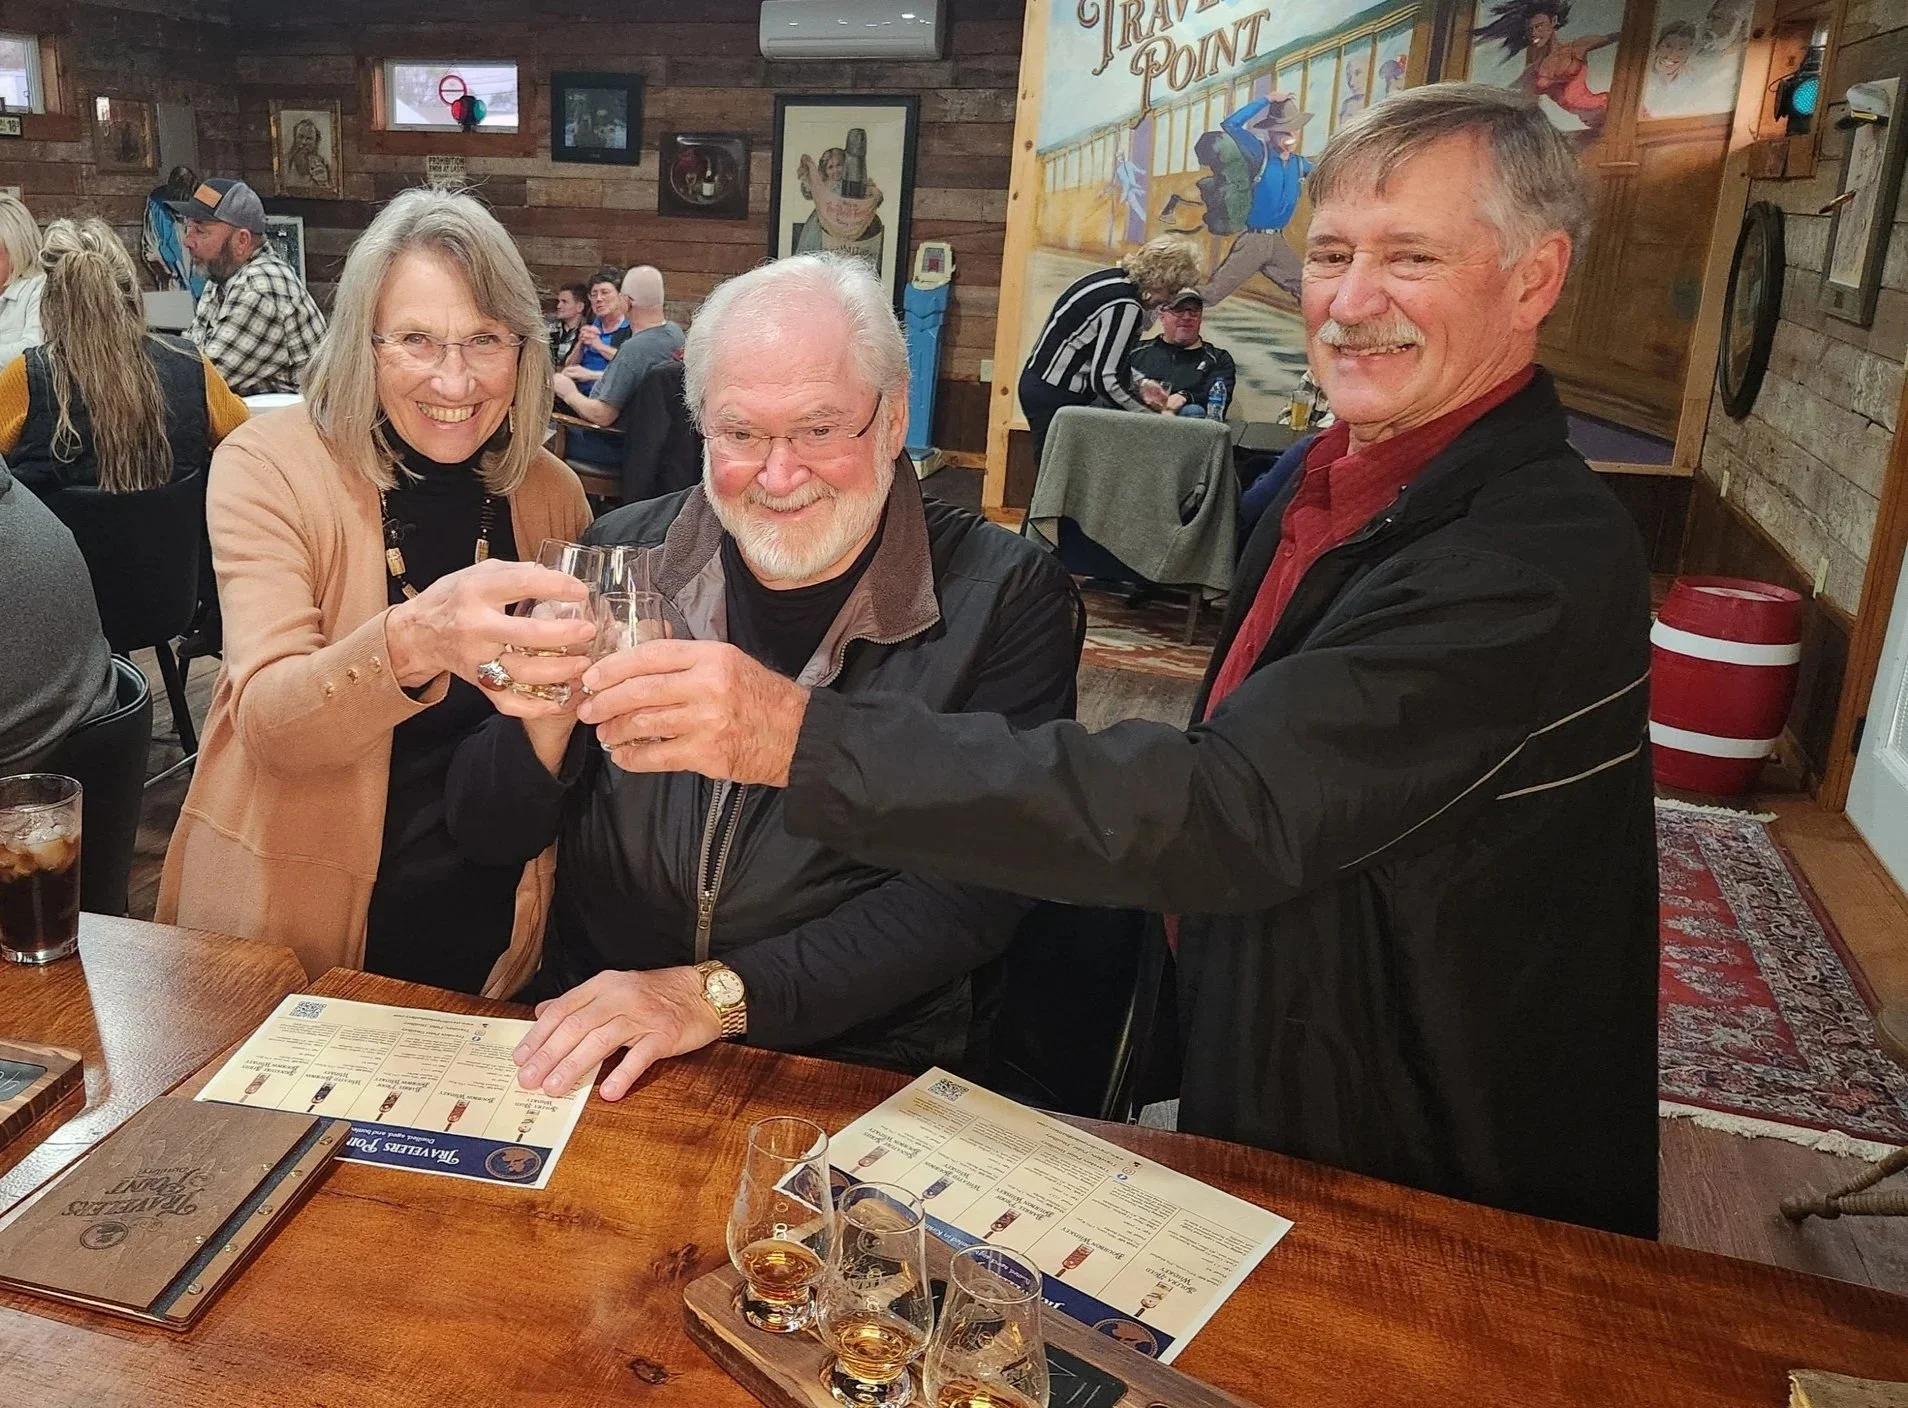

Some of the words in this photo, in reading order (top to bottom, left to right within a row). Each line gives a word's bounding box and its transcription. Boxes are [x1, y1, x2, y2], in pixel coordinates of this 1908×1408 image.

[1129, 8, 1270, 129] POINT
[383, 1141, 460, 1165] TRAVELERS
[1066, 1152, 1081, 1160] Point
[944, 1164, 970, 1179] WHISKEY
[104, 1168, 200, 1195] POINT
[61, 1188, 205, 1218] TRAVELERS
[994, 1187, 1023, 1205] WHISKEY
[1019, 1206, 1044, 1221] BARREL
[1024, 1201, 1054, 1217] BOURBON
[1062, 1227, 1091, 1245] WHISKEY
[1091, 1242, 1125, 1260] BOURBON
[1161, 1267, 1192, 1286] WHISKEY
[1168, 1278, 1197, 1294] SOLERA
